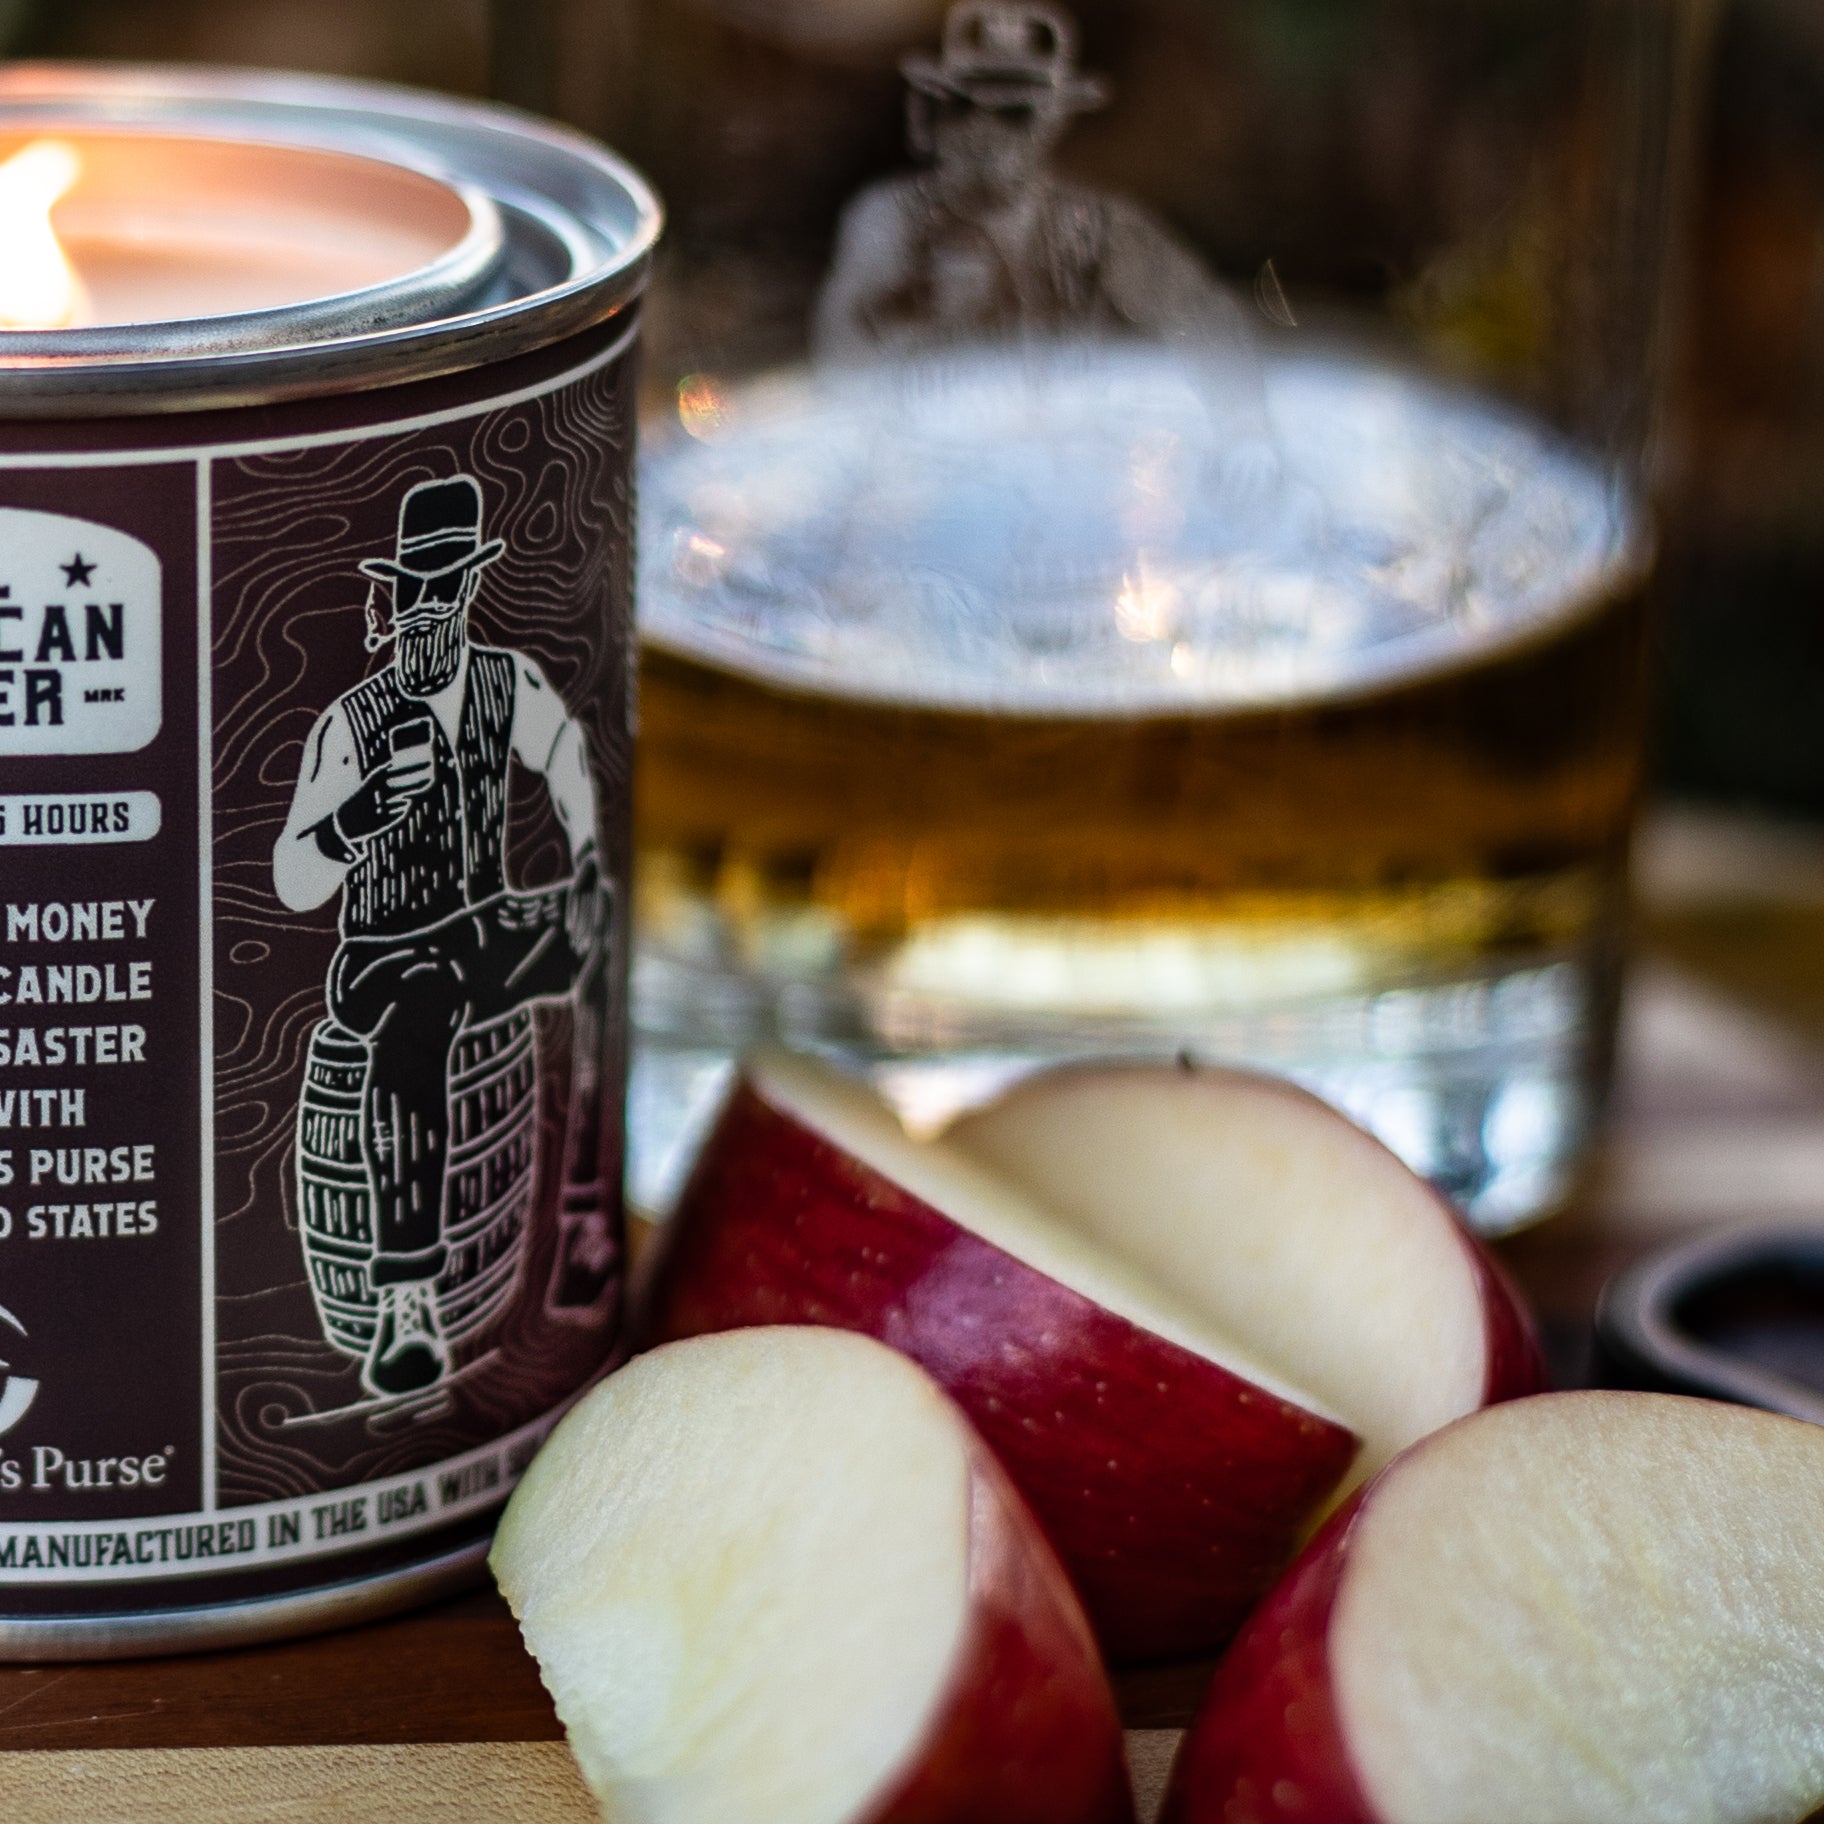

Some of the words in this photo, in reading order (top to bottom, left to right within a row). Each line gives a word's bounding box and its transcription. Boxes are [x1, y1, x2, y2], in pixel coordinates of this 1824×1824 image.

[84, 687, 126, 704] MRK
[22, 801, 130, 836] HOURS
[6, 898, 156, 942] MONEY
[29, 1144, 156, 1185] PURSE
[27, 1200, 159, 1238] STATES
[267, 1506, 301, 1548] IN
[311, 1496, 368, 1540] THE
[377, 1480, 427, 1525] USA
